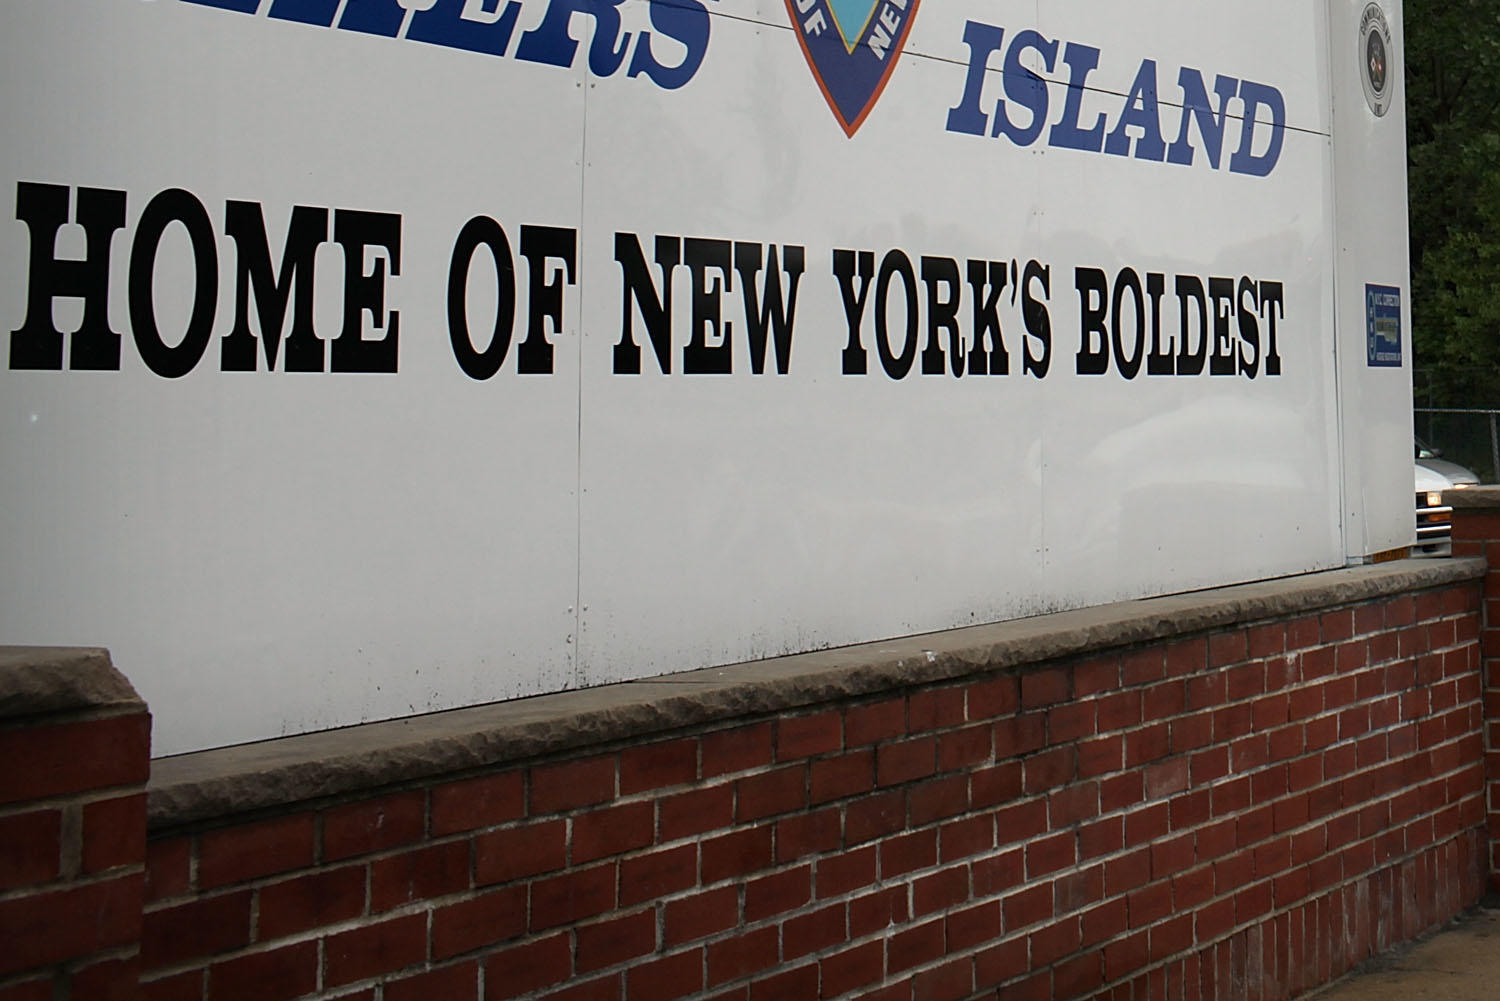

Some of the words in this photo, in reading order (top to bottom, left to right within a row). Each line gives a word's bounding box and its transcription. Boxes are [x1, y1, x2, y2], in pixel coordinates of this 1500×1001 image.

[945, 19, 1286, 177] ISLAND
[9, 180, 403, 379] HOME
[447, 215, 577, 381] OF
[613, 231, 805, 375] NEW
[832, 248, 1052, 381] YORK'S
[1074, 266, 1284, 381] BOLDEST
